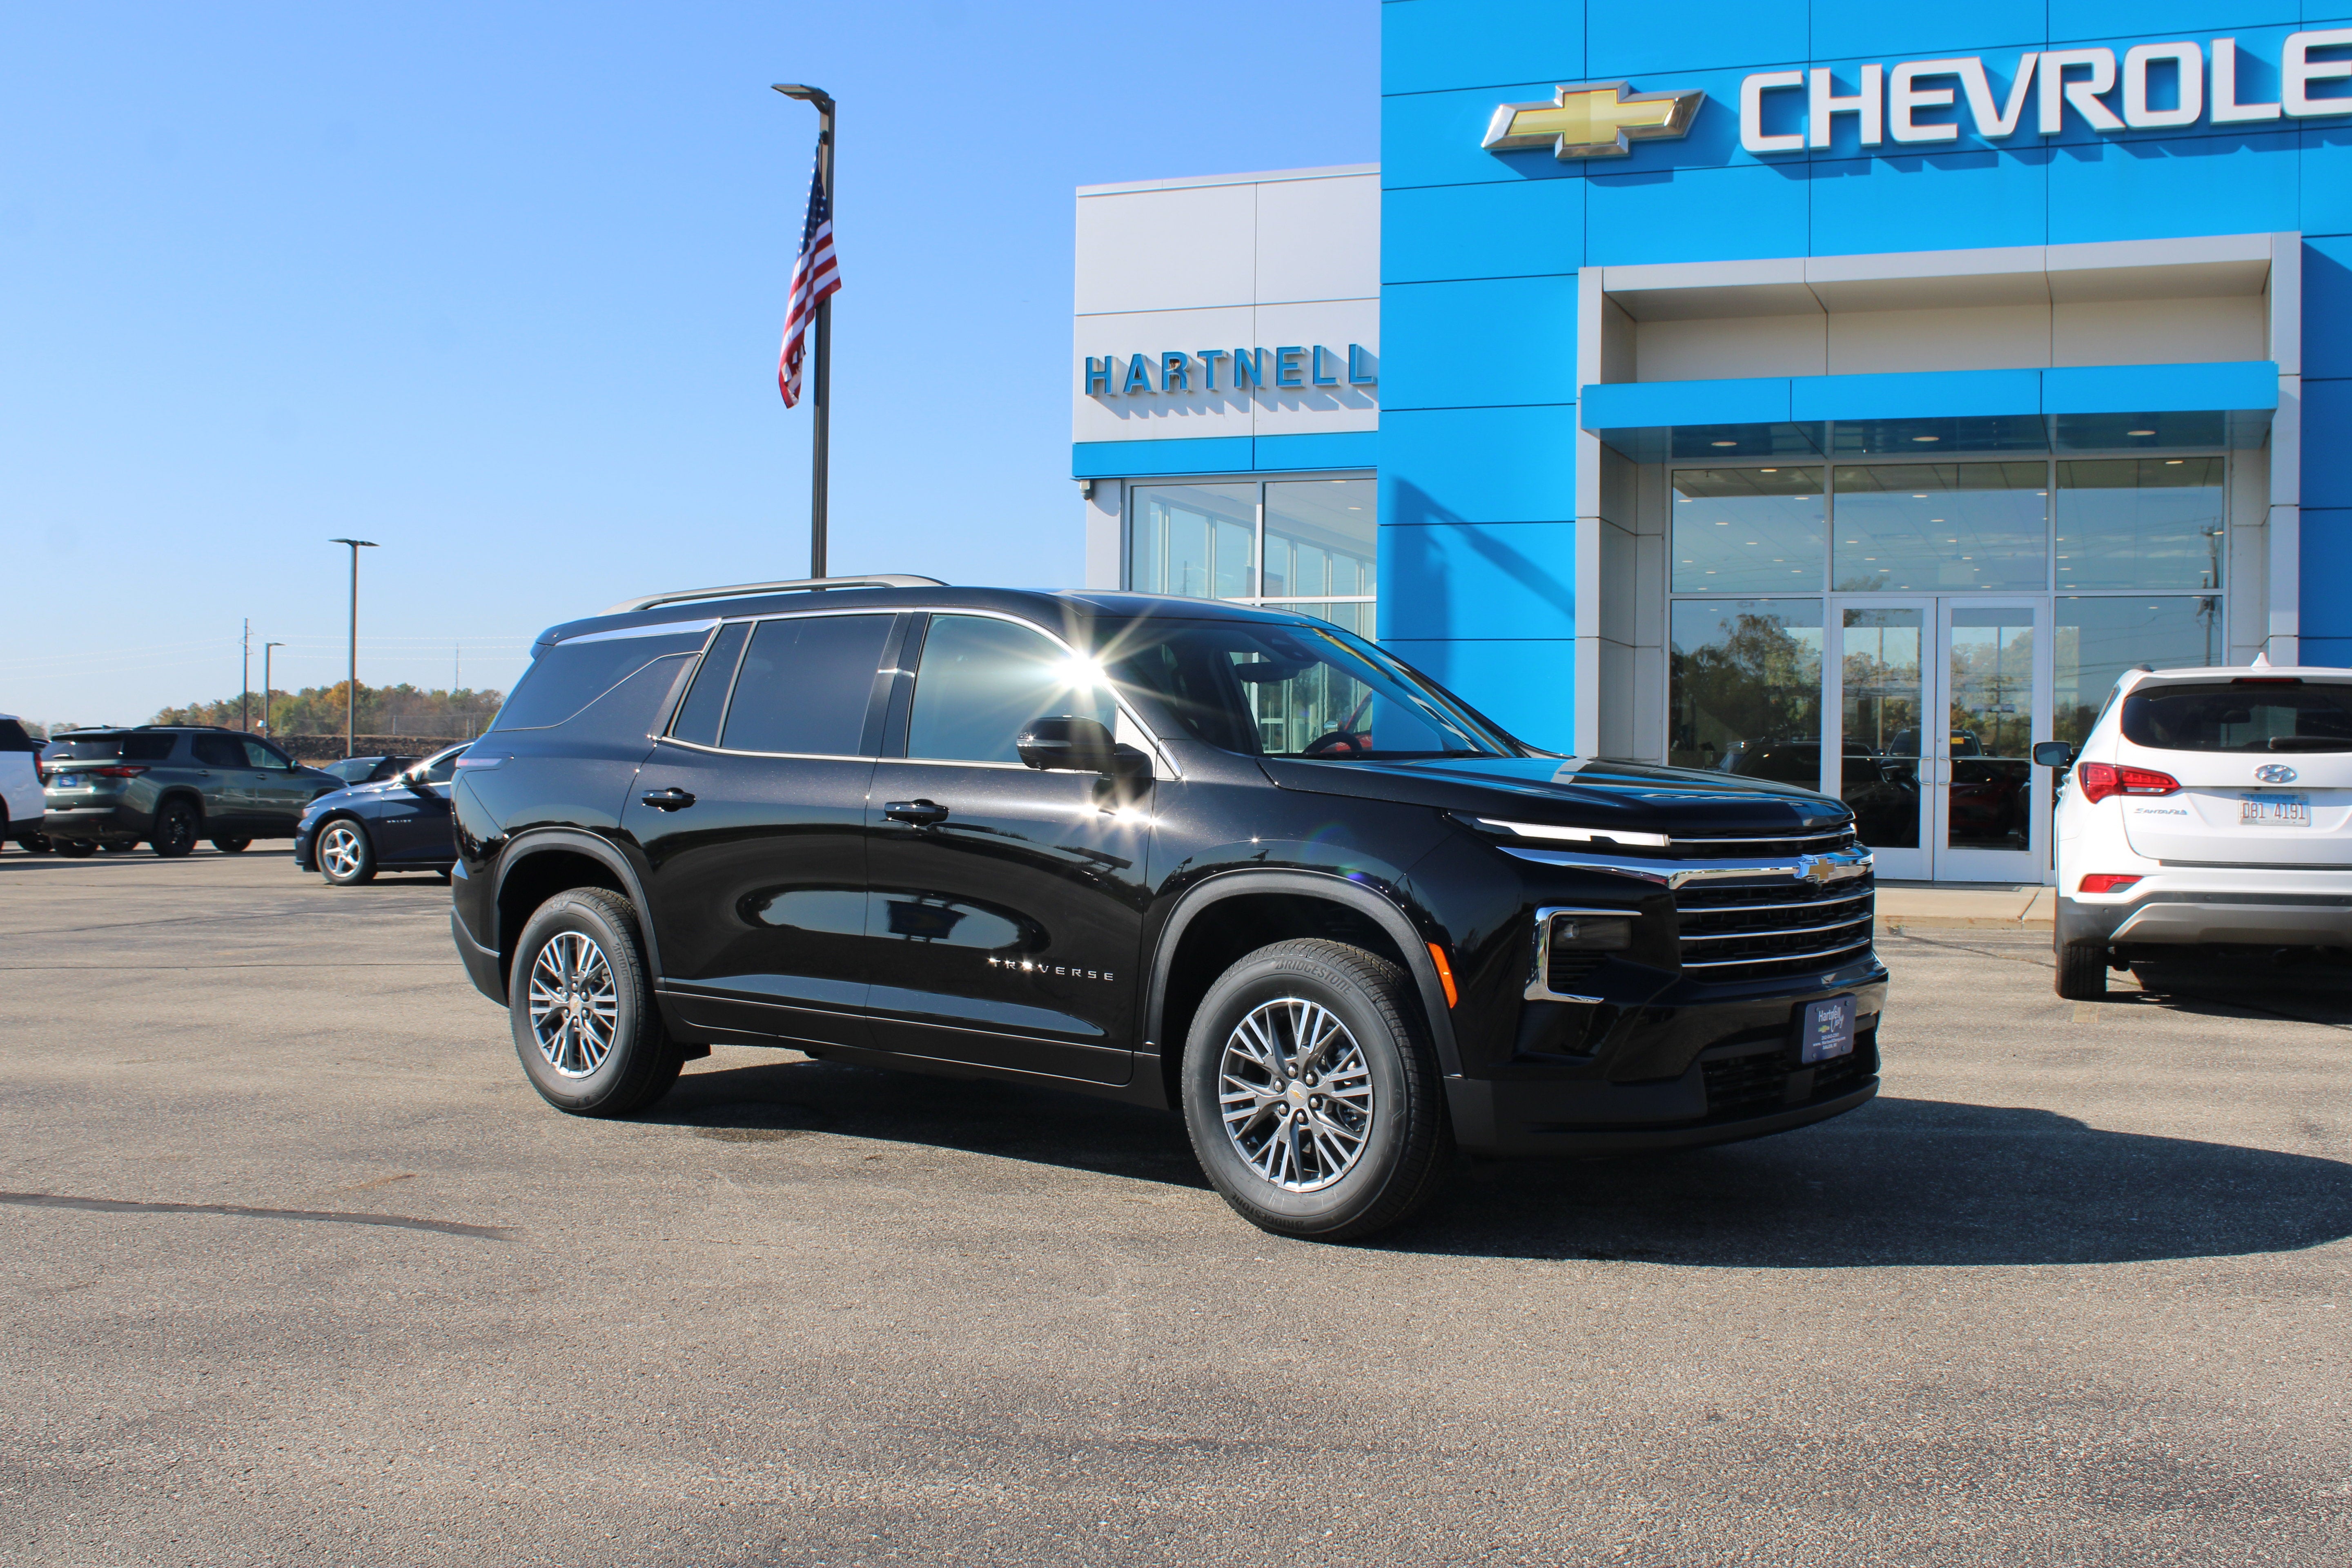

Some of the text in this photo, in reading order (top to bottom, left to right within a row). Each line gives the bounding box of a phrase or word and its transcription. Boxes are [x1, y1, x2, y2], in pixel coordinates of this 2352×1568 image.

[1085, 344, 1377, 397] HARTNELL
[2274, 803, 2305, 820] 4191
[1274, 959, 1353, 996] BRIDGESTONE
[1818, 1007, 1841, 1022] Hartnell
